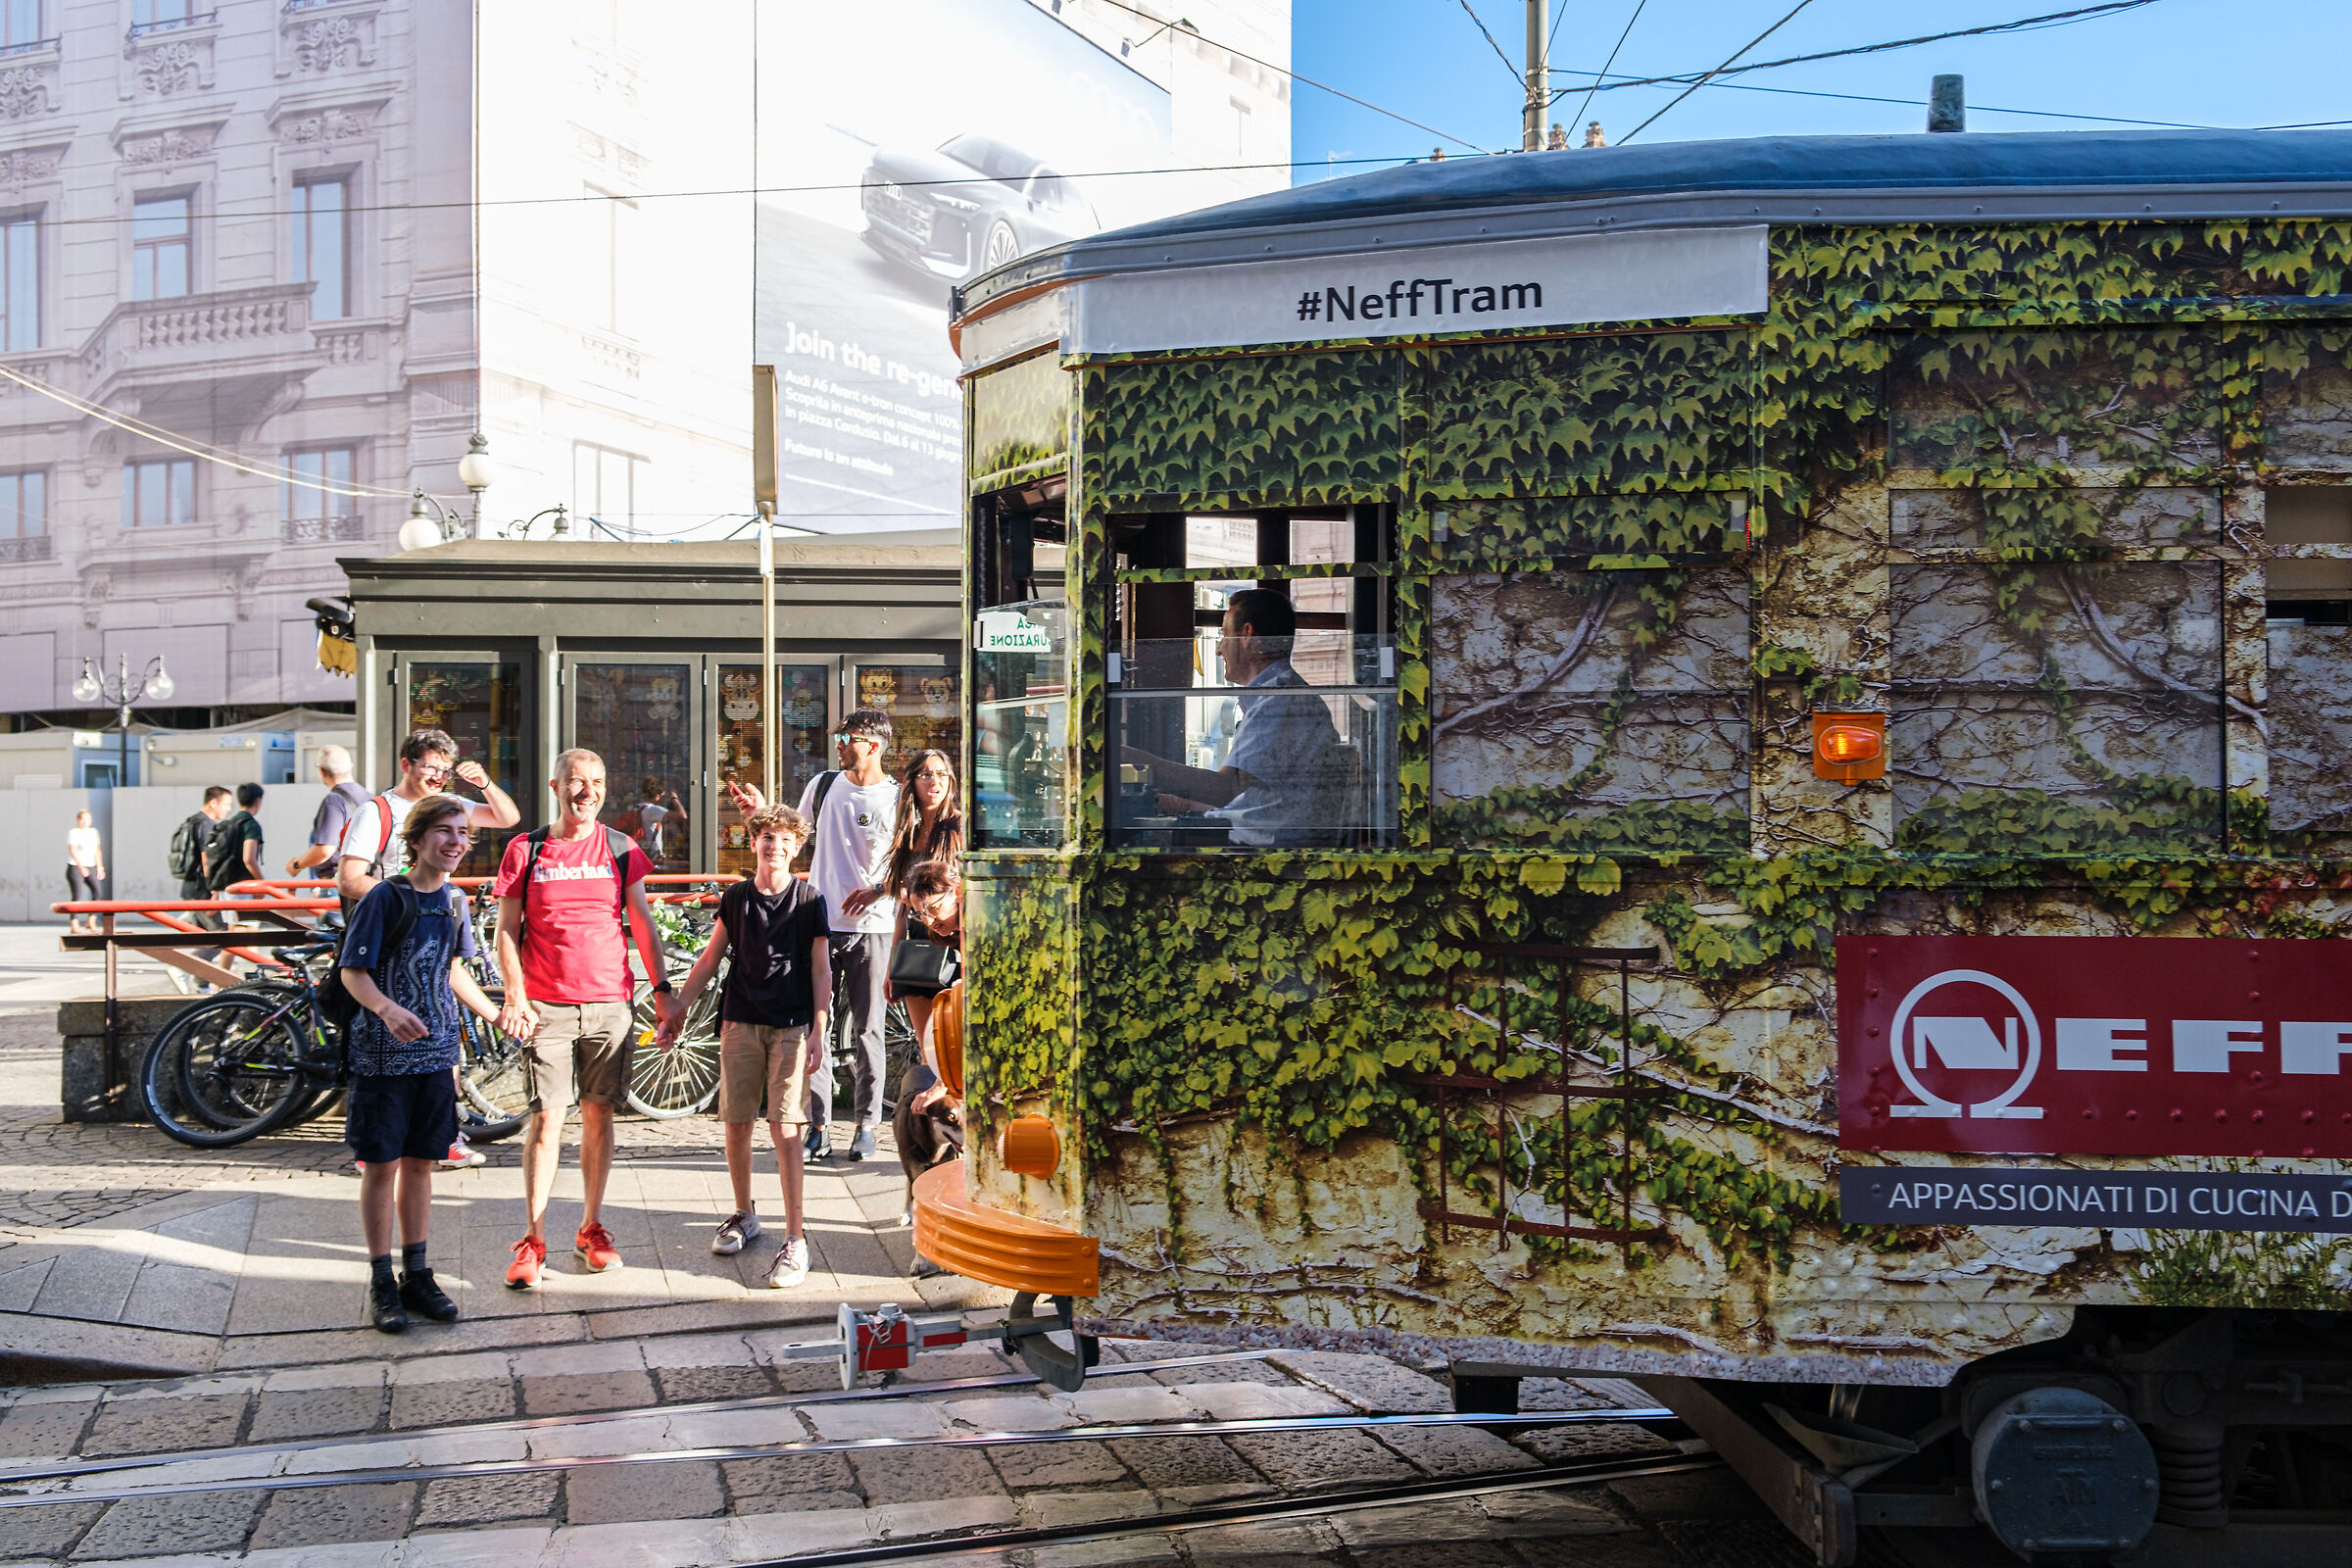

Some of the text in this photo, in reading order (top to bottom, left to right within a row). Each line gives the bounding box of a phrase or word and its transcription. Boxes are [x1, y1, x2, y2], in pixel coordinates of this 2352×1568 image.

[1296, 278, 1543, 323] #NeffTram
[784, 321, 835, 362] Join
[841, 342, 881, 375] the
[785, 369, 959, 431] Audi A6 Avant e-tron concept 100%
[785, 387, 829, 410] Scoprila
[831, 400, 842, 414] in
[843, 406, 895, 428] anteprima
[784, 438, 822, 460] Future
[785, 405, 796, 418] in
[798, 410, 832, 428] piazza
[883, 430, 900, 447] Dal
[901, 436, 908, 448] 6
[921, 441, 934, 456] 13
[1913, 1016, 2352, 1075] NEFF
[1888, 1182, 2133, 1215] APPASSIONATI
[2144, 1187, 2178, 1214] DI
[2188, 1187, 2319, 1217] CUCINA
